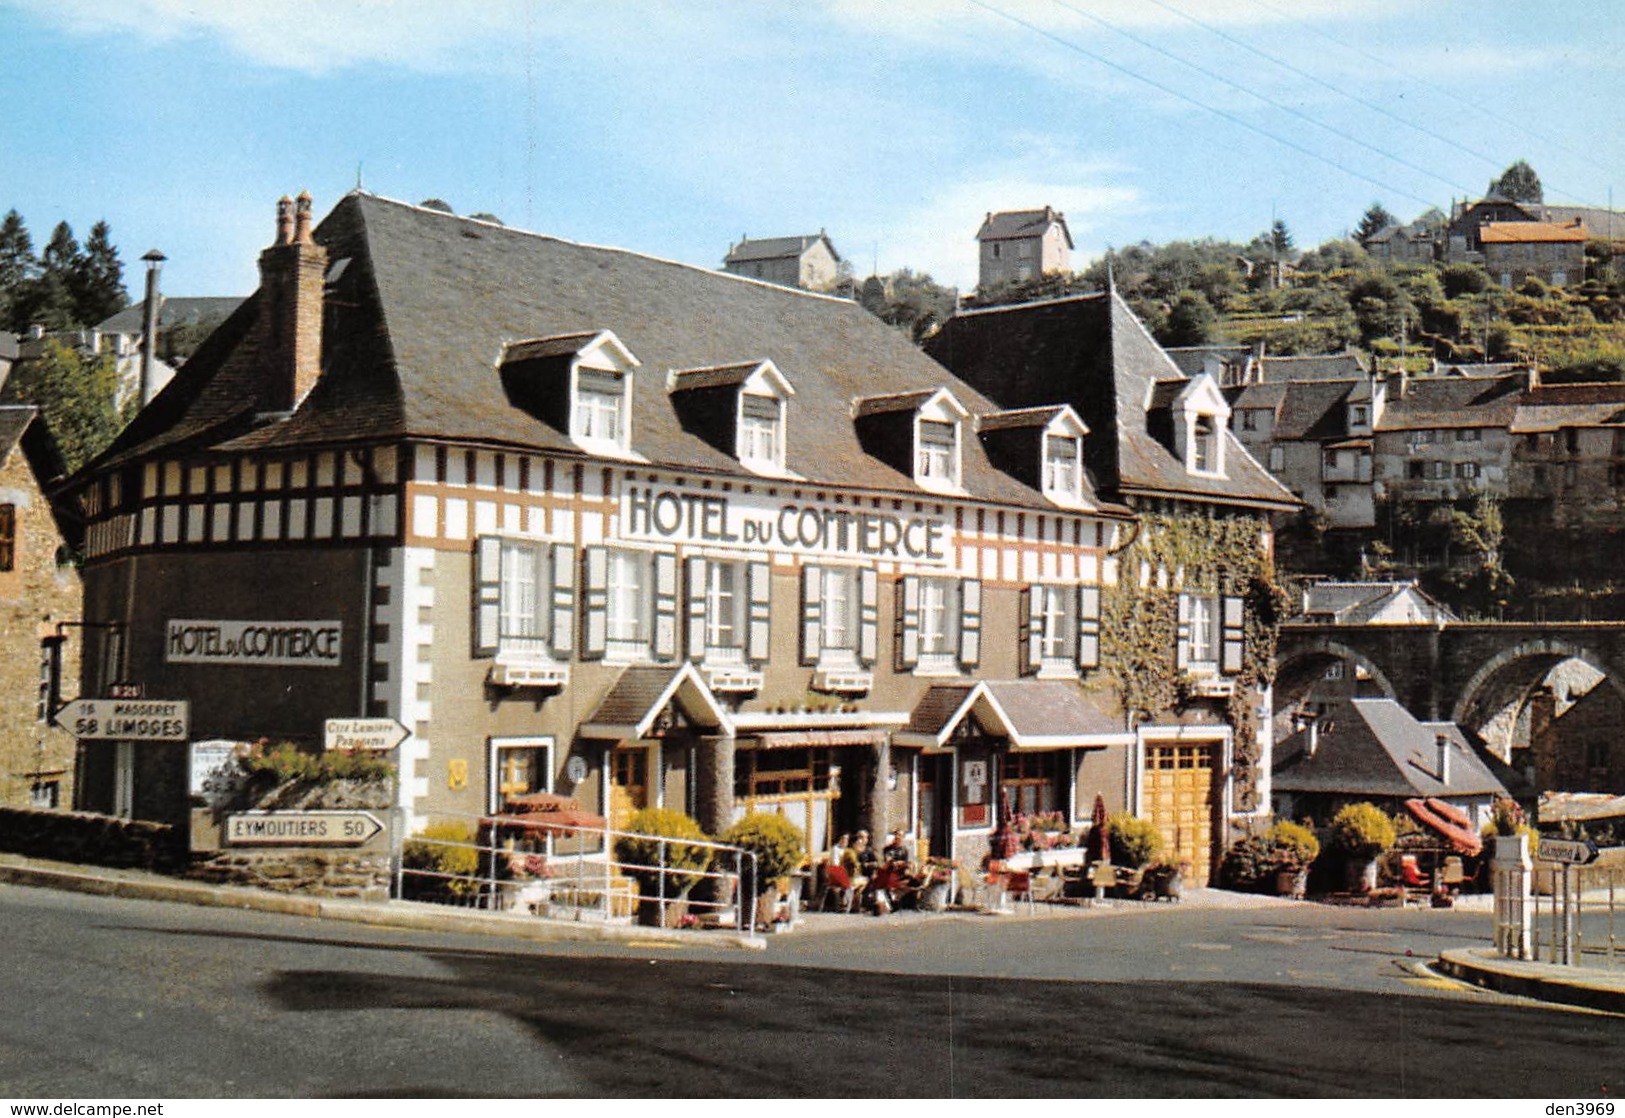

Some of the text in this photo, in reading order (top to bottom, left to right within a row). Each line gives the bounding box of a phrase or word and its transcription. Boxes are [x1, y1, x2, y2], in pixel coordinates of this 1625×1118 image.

[629, 486, 945, 560] HOTEL DU COMMERCE
[170, 624, 227, 656] HOTEL
[241, 625, 339, 659] COMMERCE
[114, 704, 177, 716] MASSERET
[75, 718, 184, 736] 58 LIMOGES
[236, 820, 365, 837] EYMOUTIERS 50
